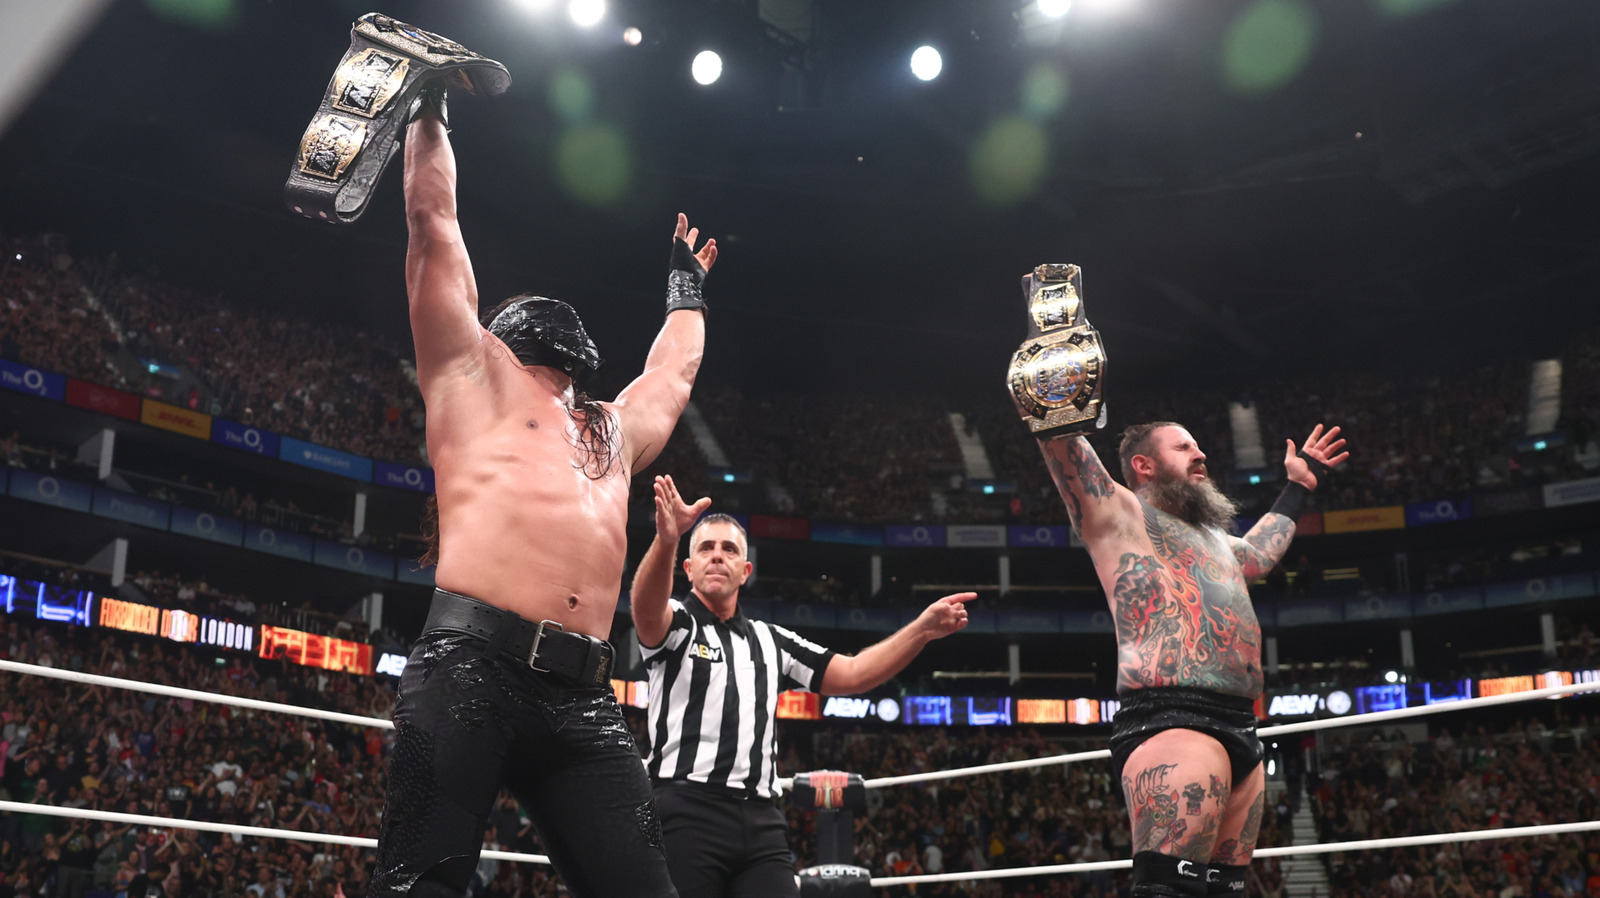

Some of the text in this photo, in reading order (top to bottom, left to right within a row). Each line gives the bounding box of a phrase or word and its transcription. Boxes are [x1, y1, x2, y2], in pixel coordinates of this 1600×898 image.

[200, 617, 253, 651] LONDON
[690, 643, 721, 661] AEW
[376, 653, 408, 678] AE
[823, 696, 870, 719] AEW
[1268, 694, 1319, 716] AEW
